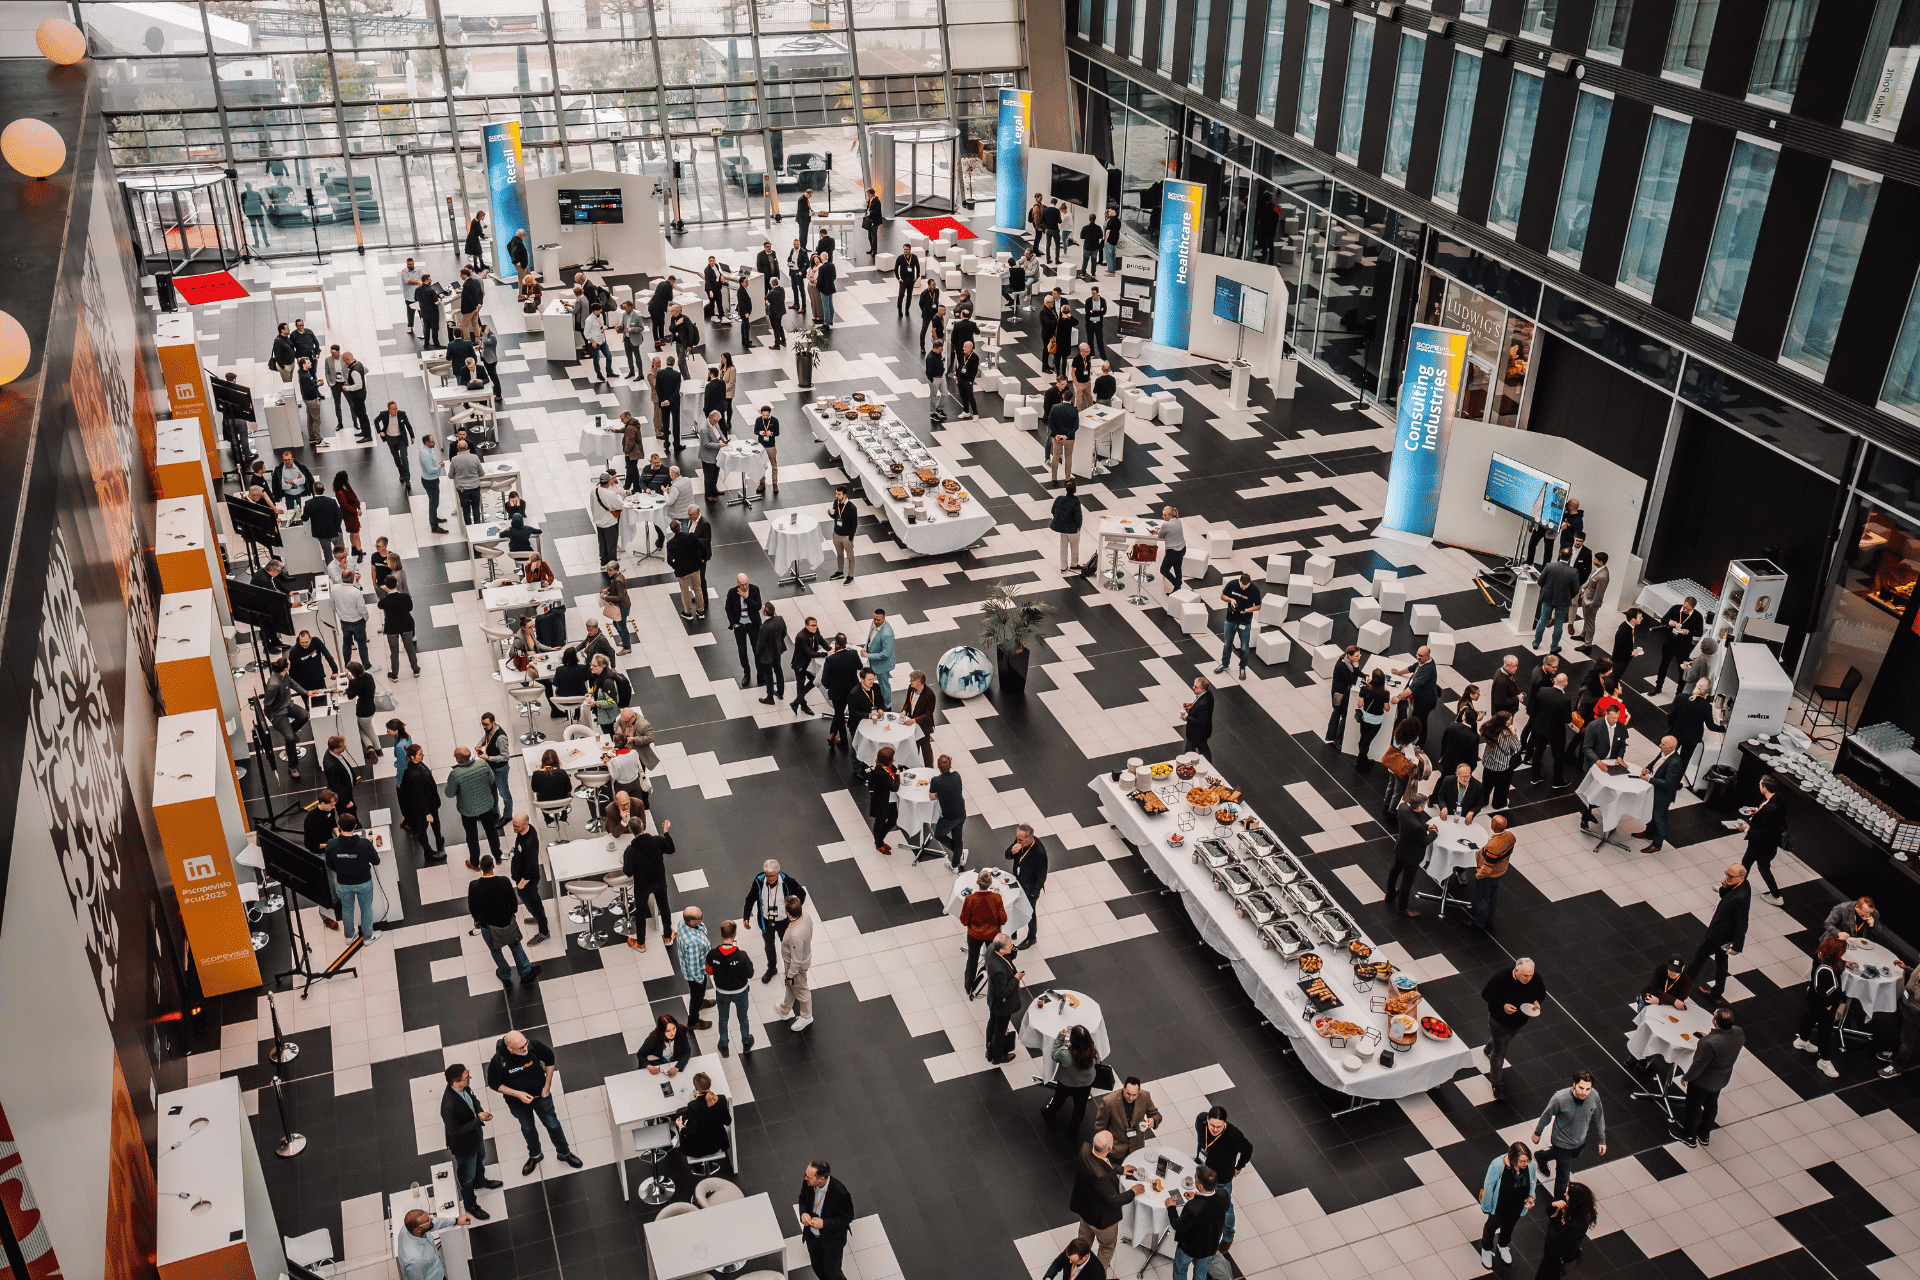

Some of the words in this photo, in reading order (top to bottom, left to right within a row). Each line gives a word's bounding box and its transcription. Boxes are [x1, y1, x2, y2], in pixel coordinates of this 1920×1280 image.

[1013, 115, 1025, 145] Legal
[503, 149, 517, 184] Retail
[1176, 212, 1192, 284] Healthcare
[1447, 299, 1501, 338] LUDWIG'S
[1461, 321, 1482, 338] BONN
[1404, 364, 1434, 451] Consulting
[1421, 368, 1448, 451] Industries
[182, 881, 232, 895] #scopevisio
[184, 890, 227, 904] #cut2025
[200, 949, 249, 964] SCOPEVISIO
